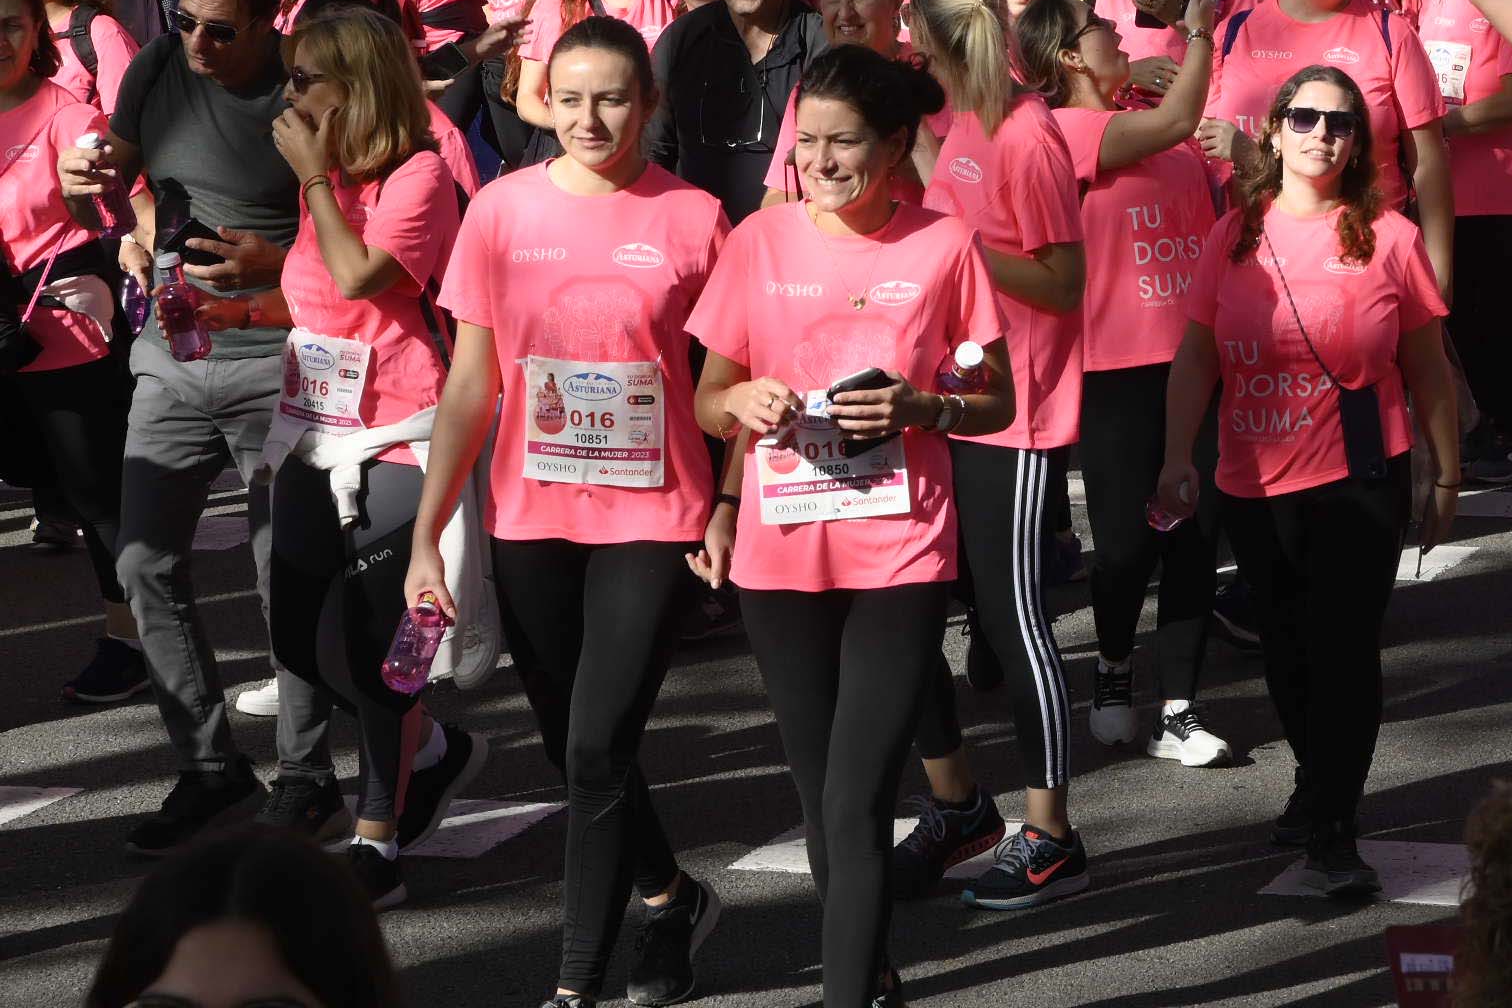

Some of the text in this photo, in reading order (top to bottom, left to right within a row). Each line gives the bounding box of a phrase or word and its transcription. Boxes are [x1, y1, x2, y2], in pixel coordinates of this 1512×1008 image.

[1251, 49, 1293, 60] OYSHO
[1437, 73, 1448, 84] 16
[1127, 204, 1161, 231] TU
[512, 247, 566, 263] OYSHO
[766, 280, 823, 297] OYSHO
[1139, 272, 1193, 299] SUM
[339, 354, 361, 362] SUMA
[1223, 340, 1258, 366] TU
[302, 377, 329, 396] 016
[567, 381, 617, 394] ASTURIANA
[304, 397, 325, 411] 20415
[570, 410, 615, 428] 016
[1232, 407, 1313, 433] SUMA
[574, 433, 608, 445] 10851
[540, 446, 575, 455] CARRERA
[537, 461, 577, 474] OYSHO
[609, 466, 654, 477] Santander
[813, 464, 849, 477] 10850
[777, 483, 814, 494] CARRERA
[853, 495, 897, 506] Santander
[775, 502, 817, 515] OYSHO
[370, 548, 393, 564] run
